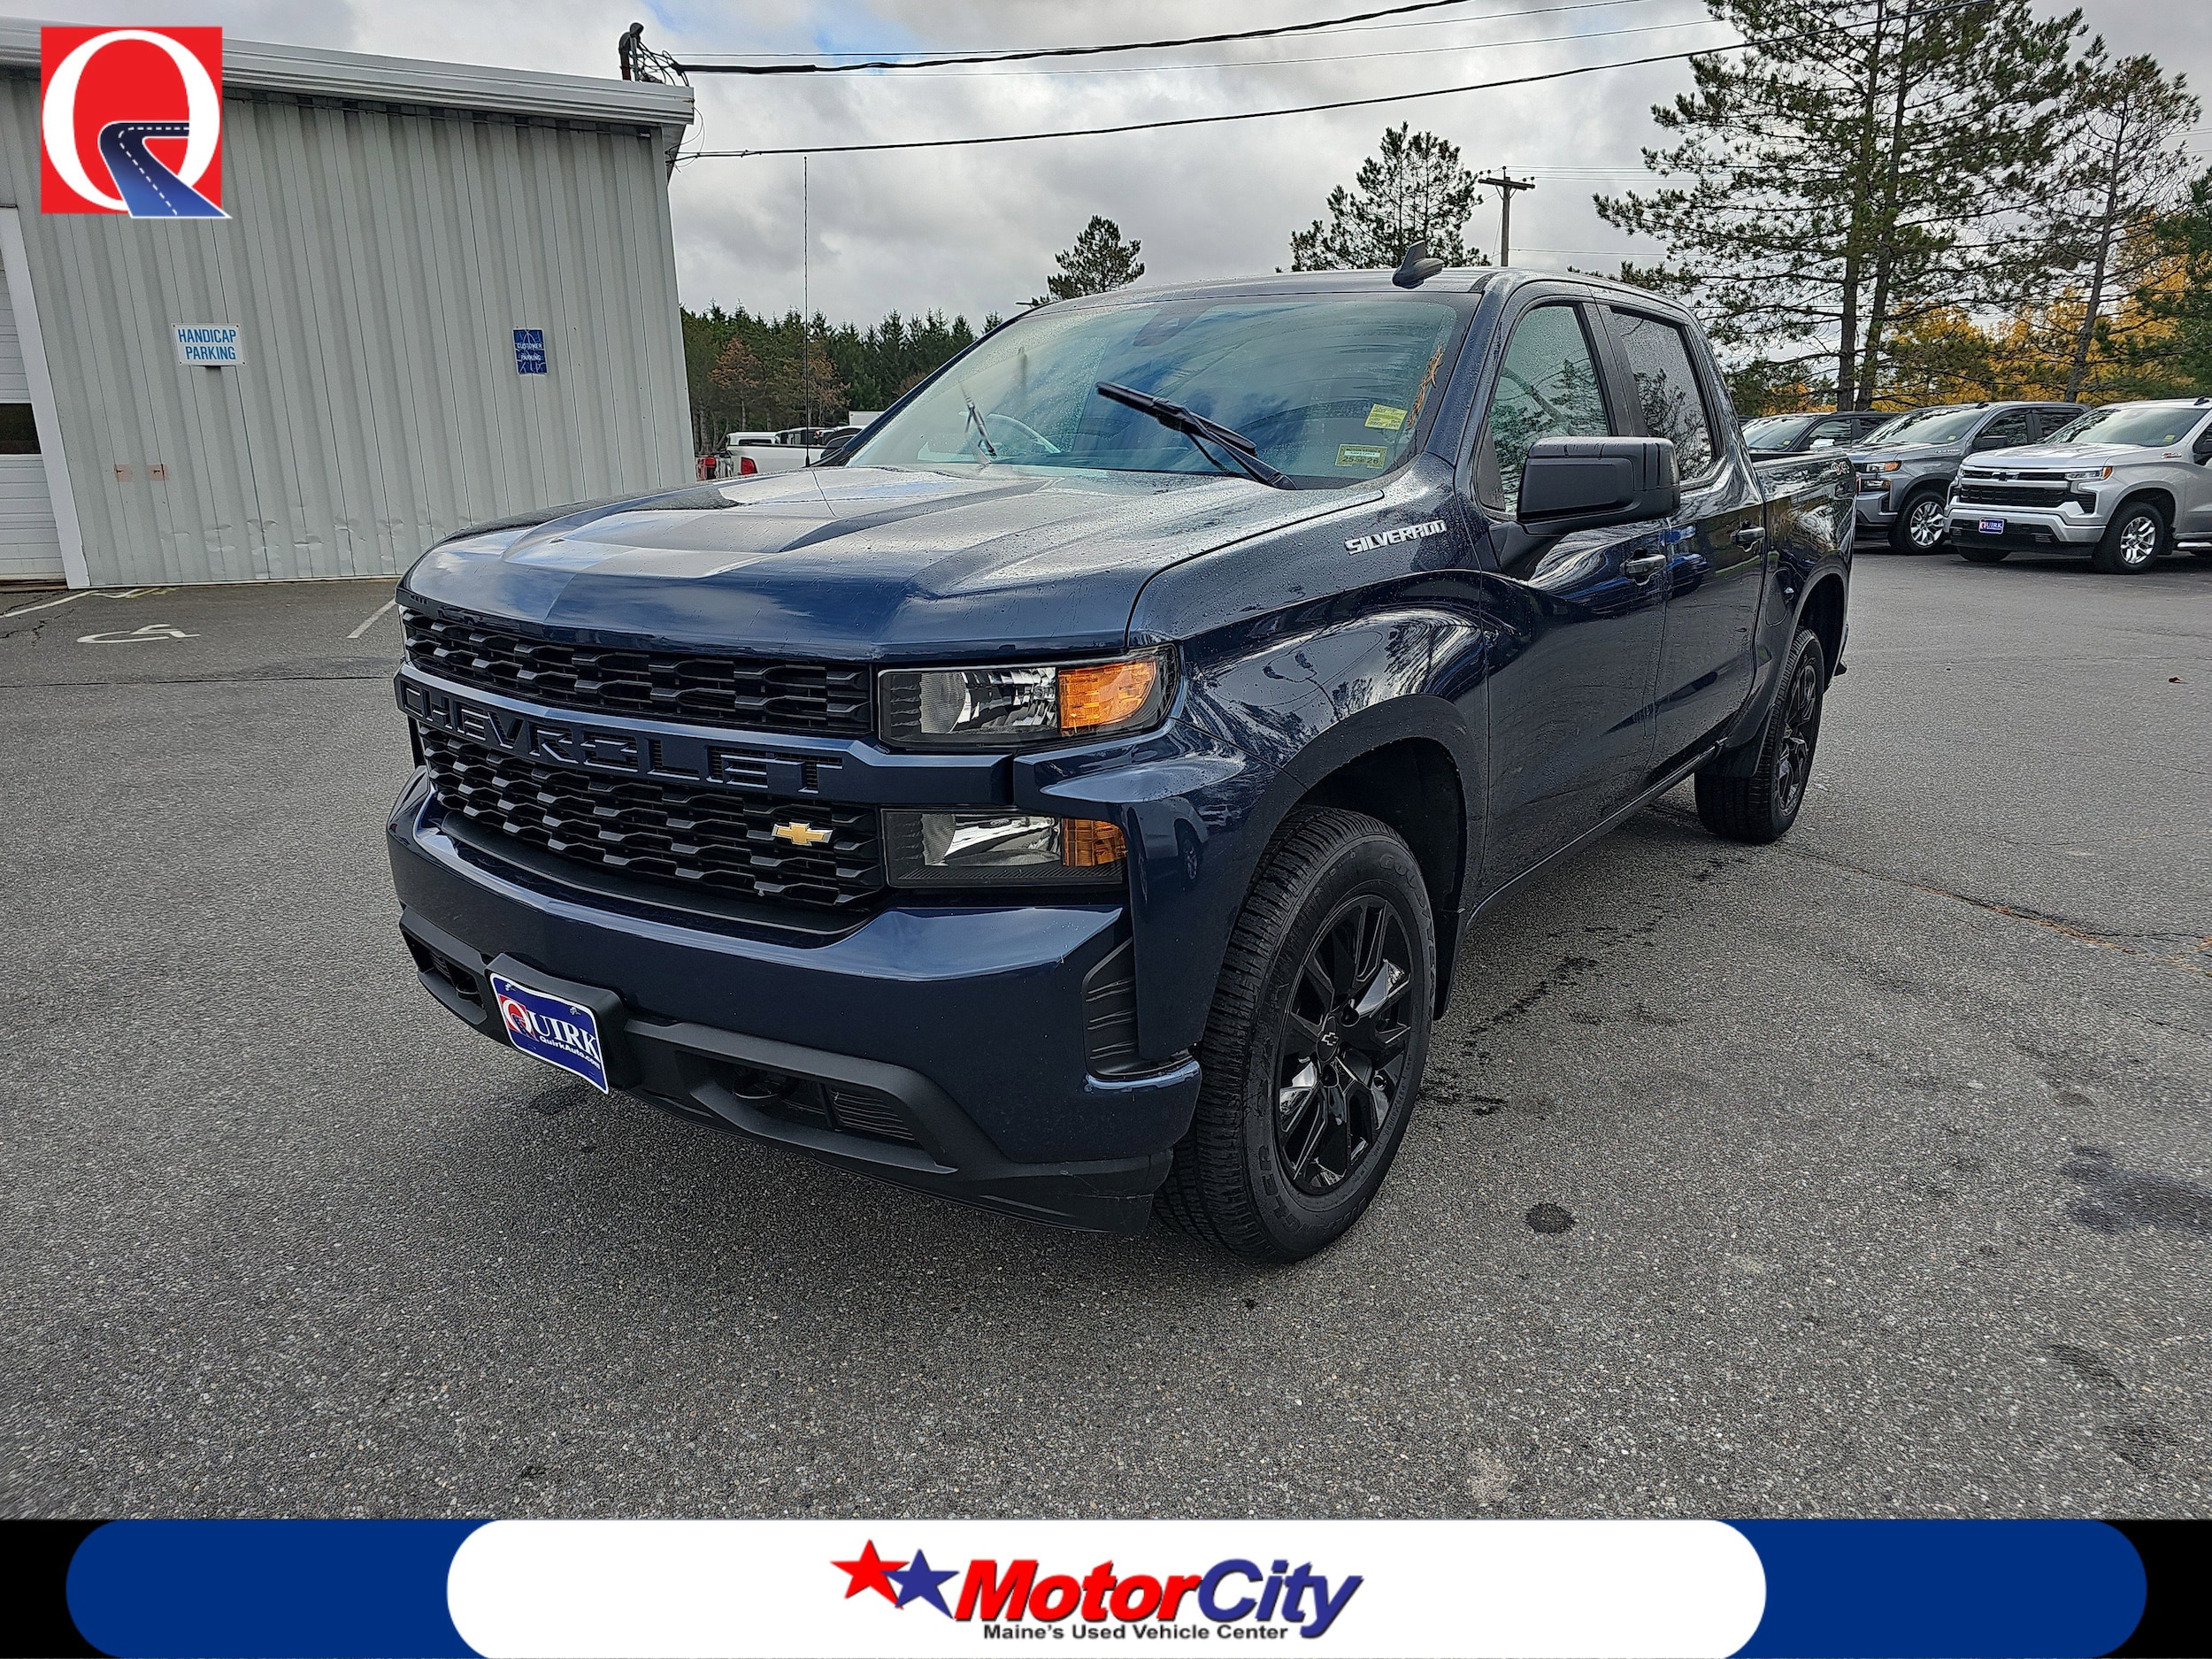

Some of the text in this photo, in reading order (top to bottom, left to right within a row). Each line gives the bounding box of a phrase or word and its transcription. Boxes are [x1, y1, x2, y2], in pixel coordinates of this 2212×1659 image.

[177, 328, 236, 343] HANDICAP
[185, 346, 236, 360] PARKING
[1344, 519, 1448, 556] SILVERADO
[1980, 521, 2002, 530] QUIRK
[403, 680, 844, 794] CHEVROLET
[503, 998, 602, 1064] QUIRK
[539, 1034, 602, 1071] QuirkAuto.com
